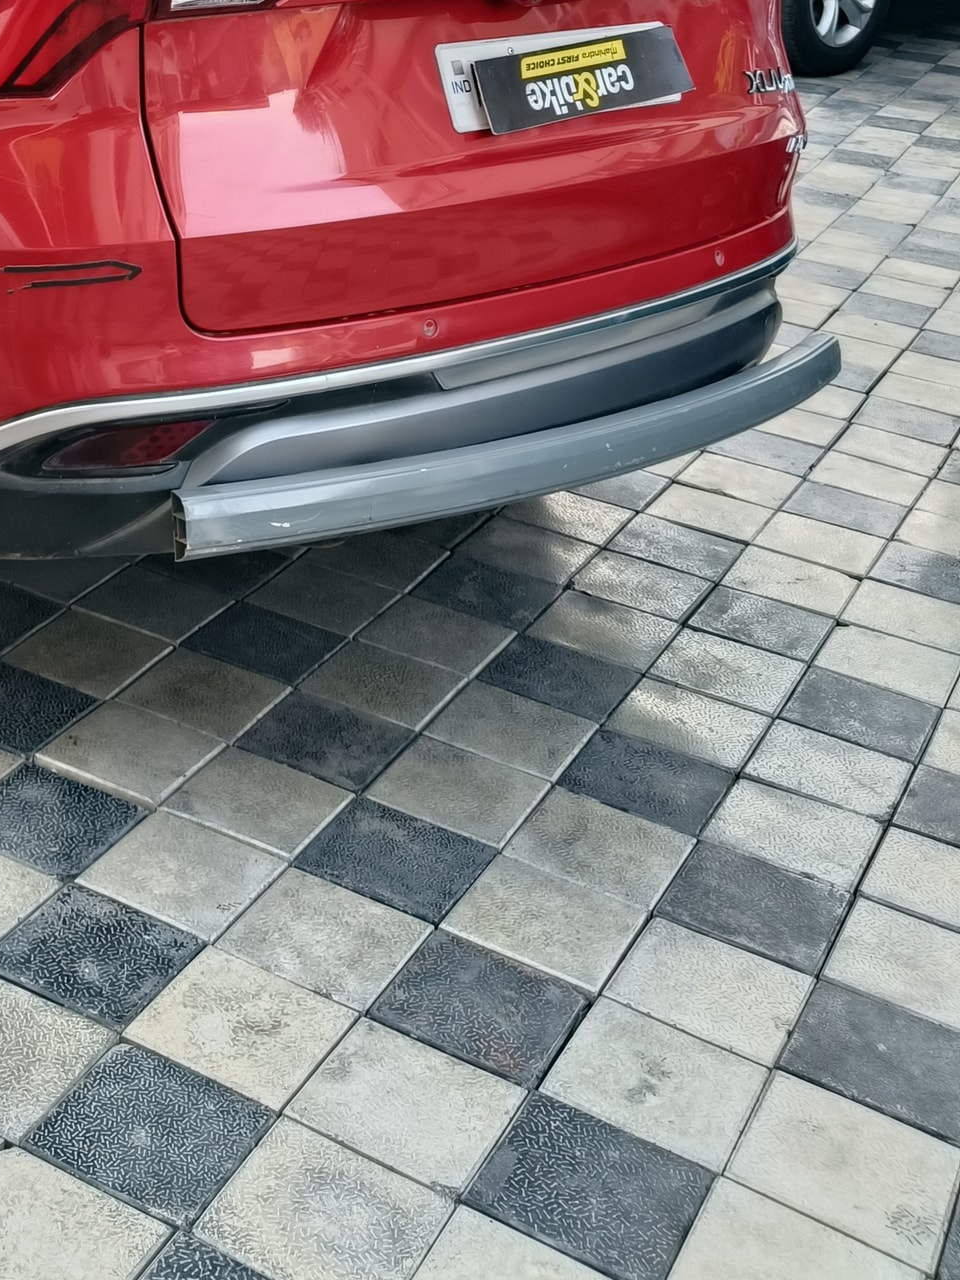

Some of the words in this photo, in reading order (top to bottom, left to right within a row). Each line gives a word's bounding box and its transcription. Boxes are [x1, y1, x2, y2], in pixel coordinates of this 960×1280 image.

[525, 58, 556, 71] CHOICE
[556, 53, 580, 67] FIRST
[451, 79, 472, 94] IND
[525, 64, 635, 116] car&bike
